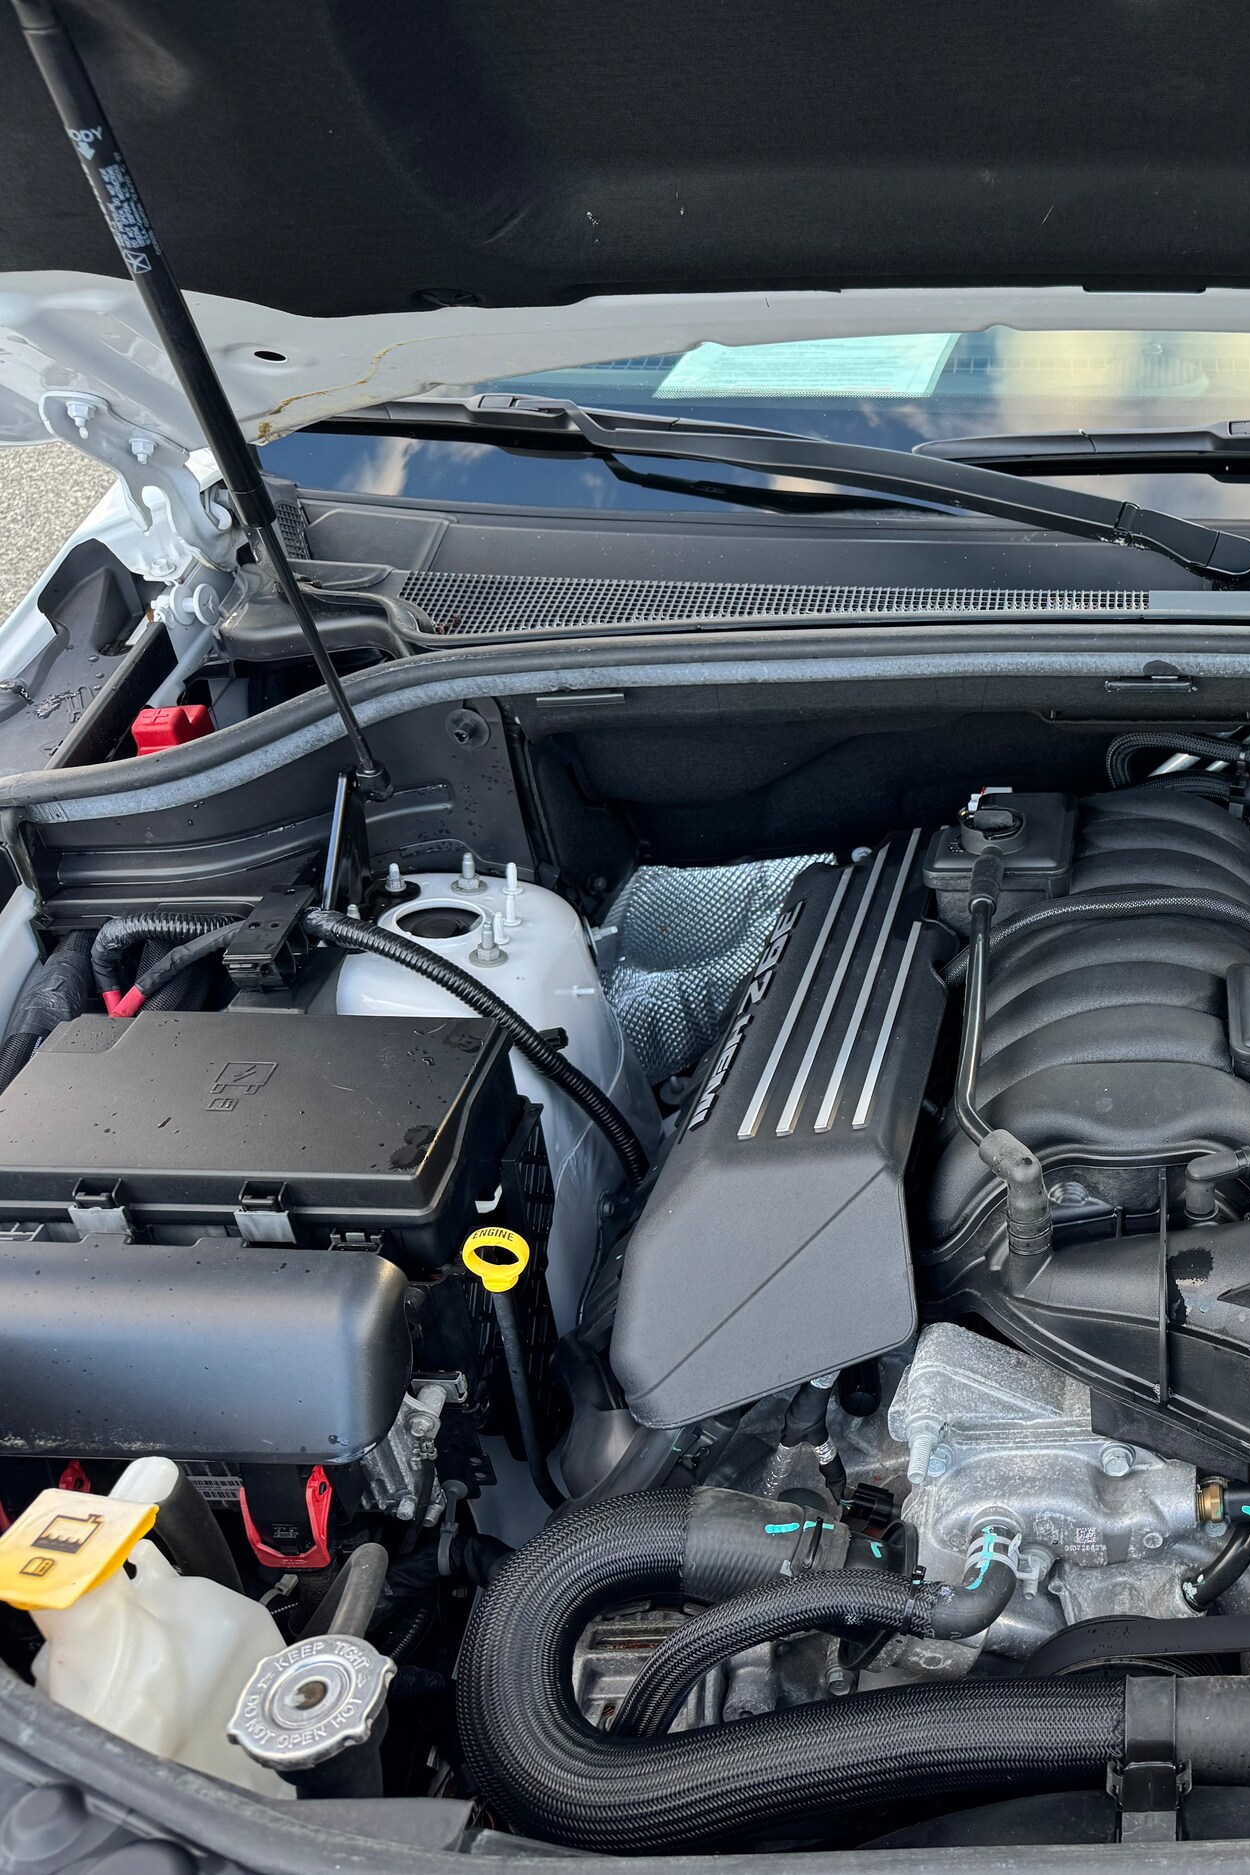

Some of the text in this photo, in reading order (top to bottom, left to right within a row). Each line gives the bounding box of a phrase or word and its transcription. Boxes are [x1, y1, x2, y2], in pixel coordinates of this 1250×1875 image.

[688, 1014, 753, 1132] HEMI
[473, 1229, 514, 1242] ENGINE
[274, 1641, 370, 1671] KEEP TIGHT
[244, 1695, 363, 1749] DO NOT OPEN HOT
